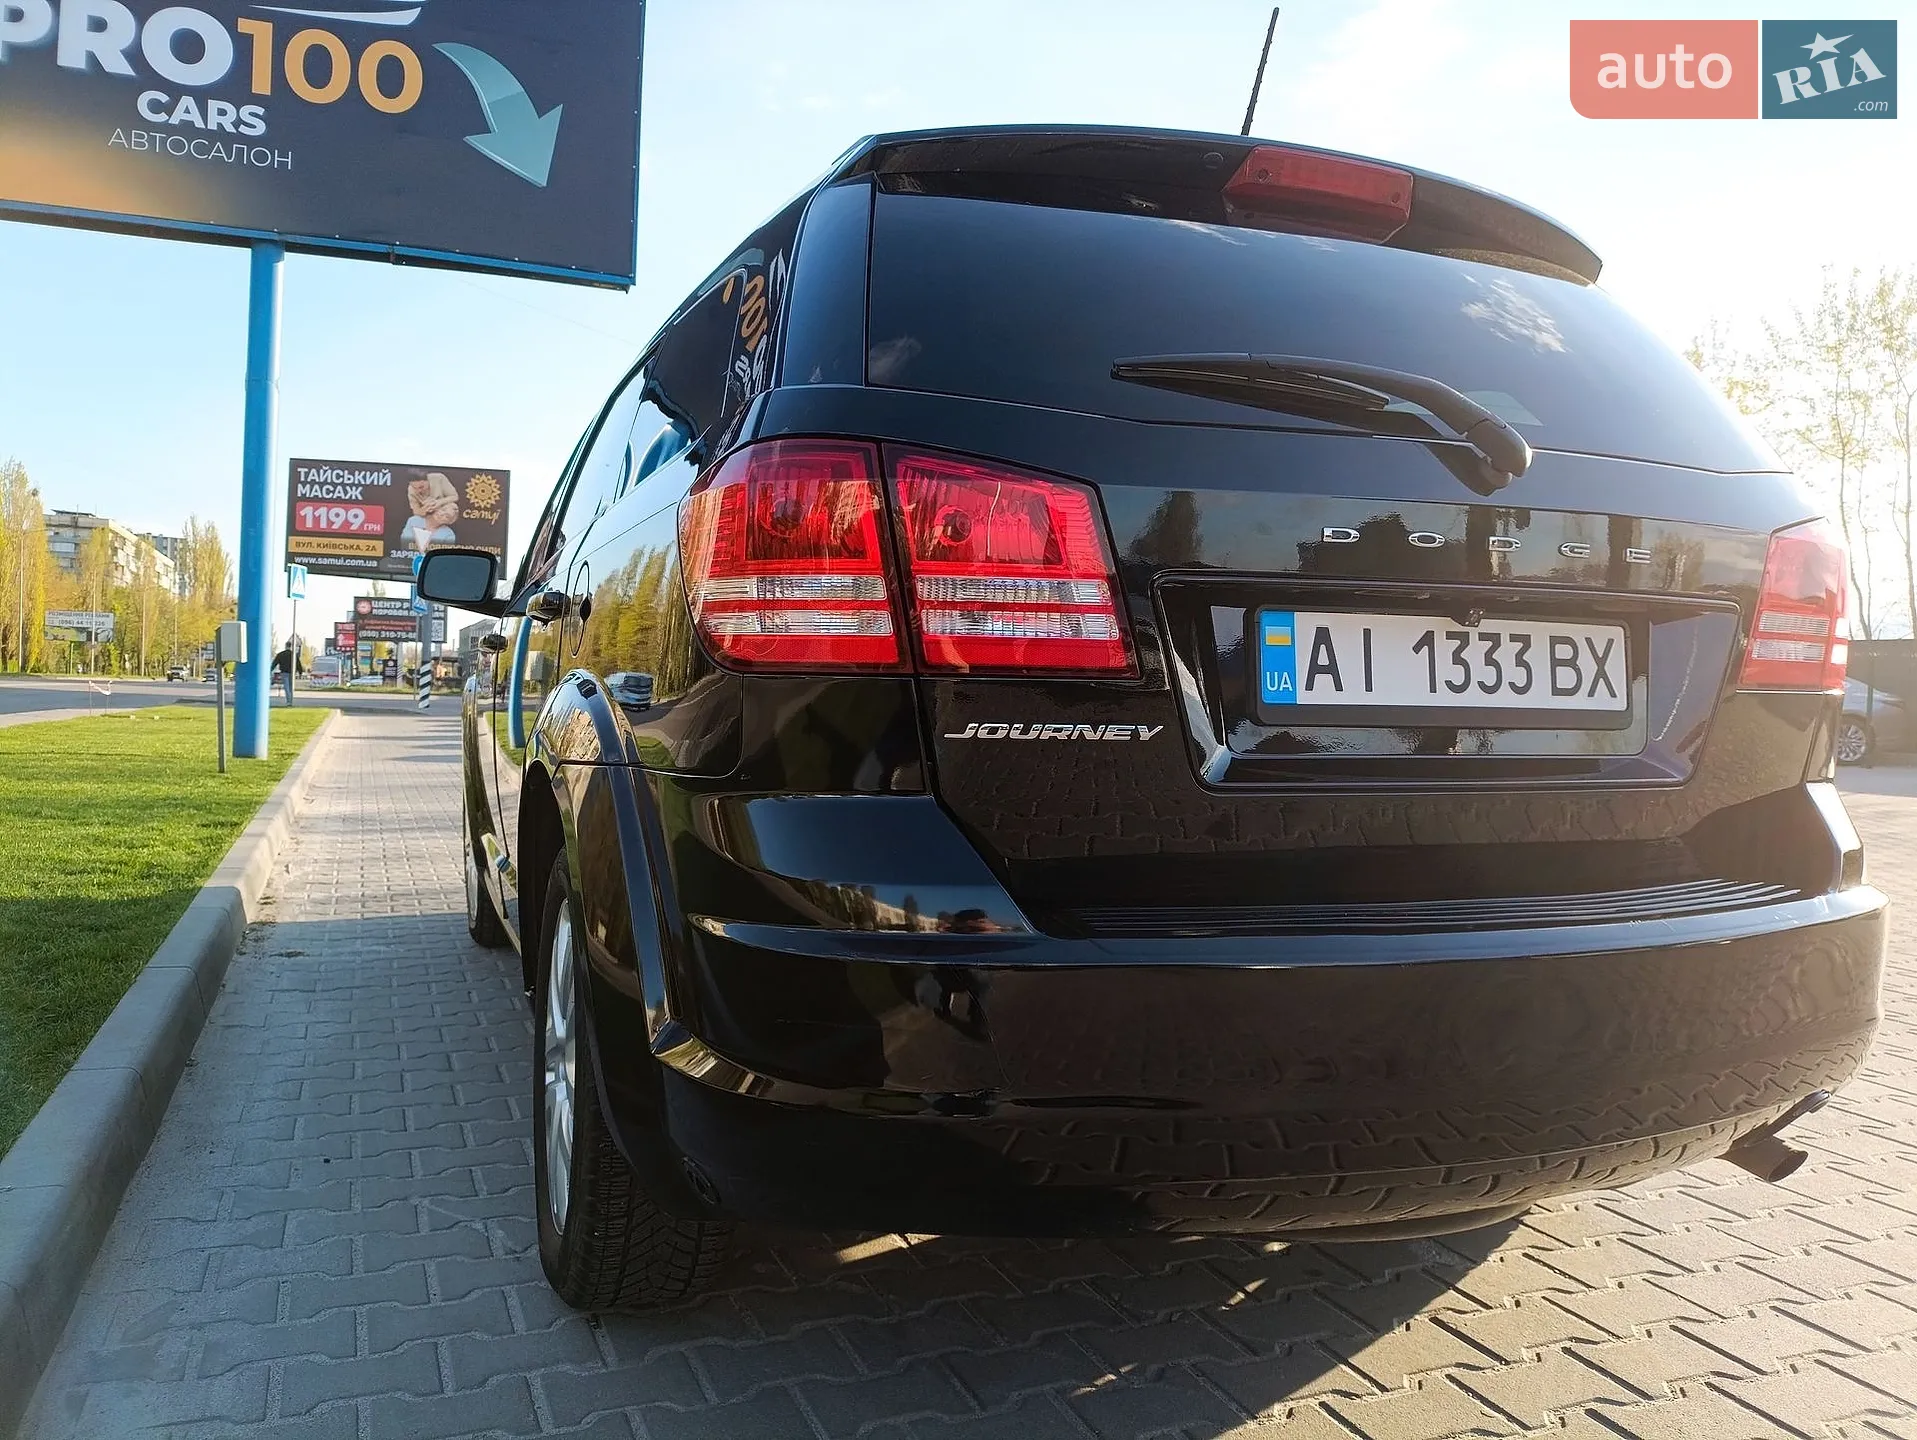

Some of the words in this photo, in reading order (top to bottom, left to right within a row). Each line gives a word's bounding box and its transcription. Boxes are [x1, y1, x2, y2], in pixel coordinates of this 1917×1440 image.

[0, 0, 424, 114] PRO100
[136, 90, 267, 136] CARS
[107, 127, 293, 170] АВТОСАЛОН
[297, 465, 391, 486] ТАЙСЬКИЙ
[297, 483, 363, 500] МАСАЖ
[300, 505, 365, 530] 1199
[295, 541, 314, 549] ВУЛ.
[1323, 526, 1652, 564] DODGE
[294, 556, 378, 567] www.samui.com.ua
[1305, 626, 1373, 692] AI
[1412, 629, 1533, 696] 1333
[1549, 635, 1617, 698] BX
[1266, 671, 1293, 692] UA
[944, 723, 1164, 741] JOURNEY
